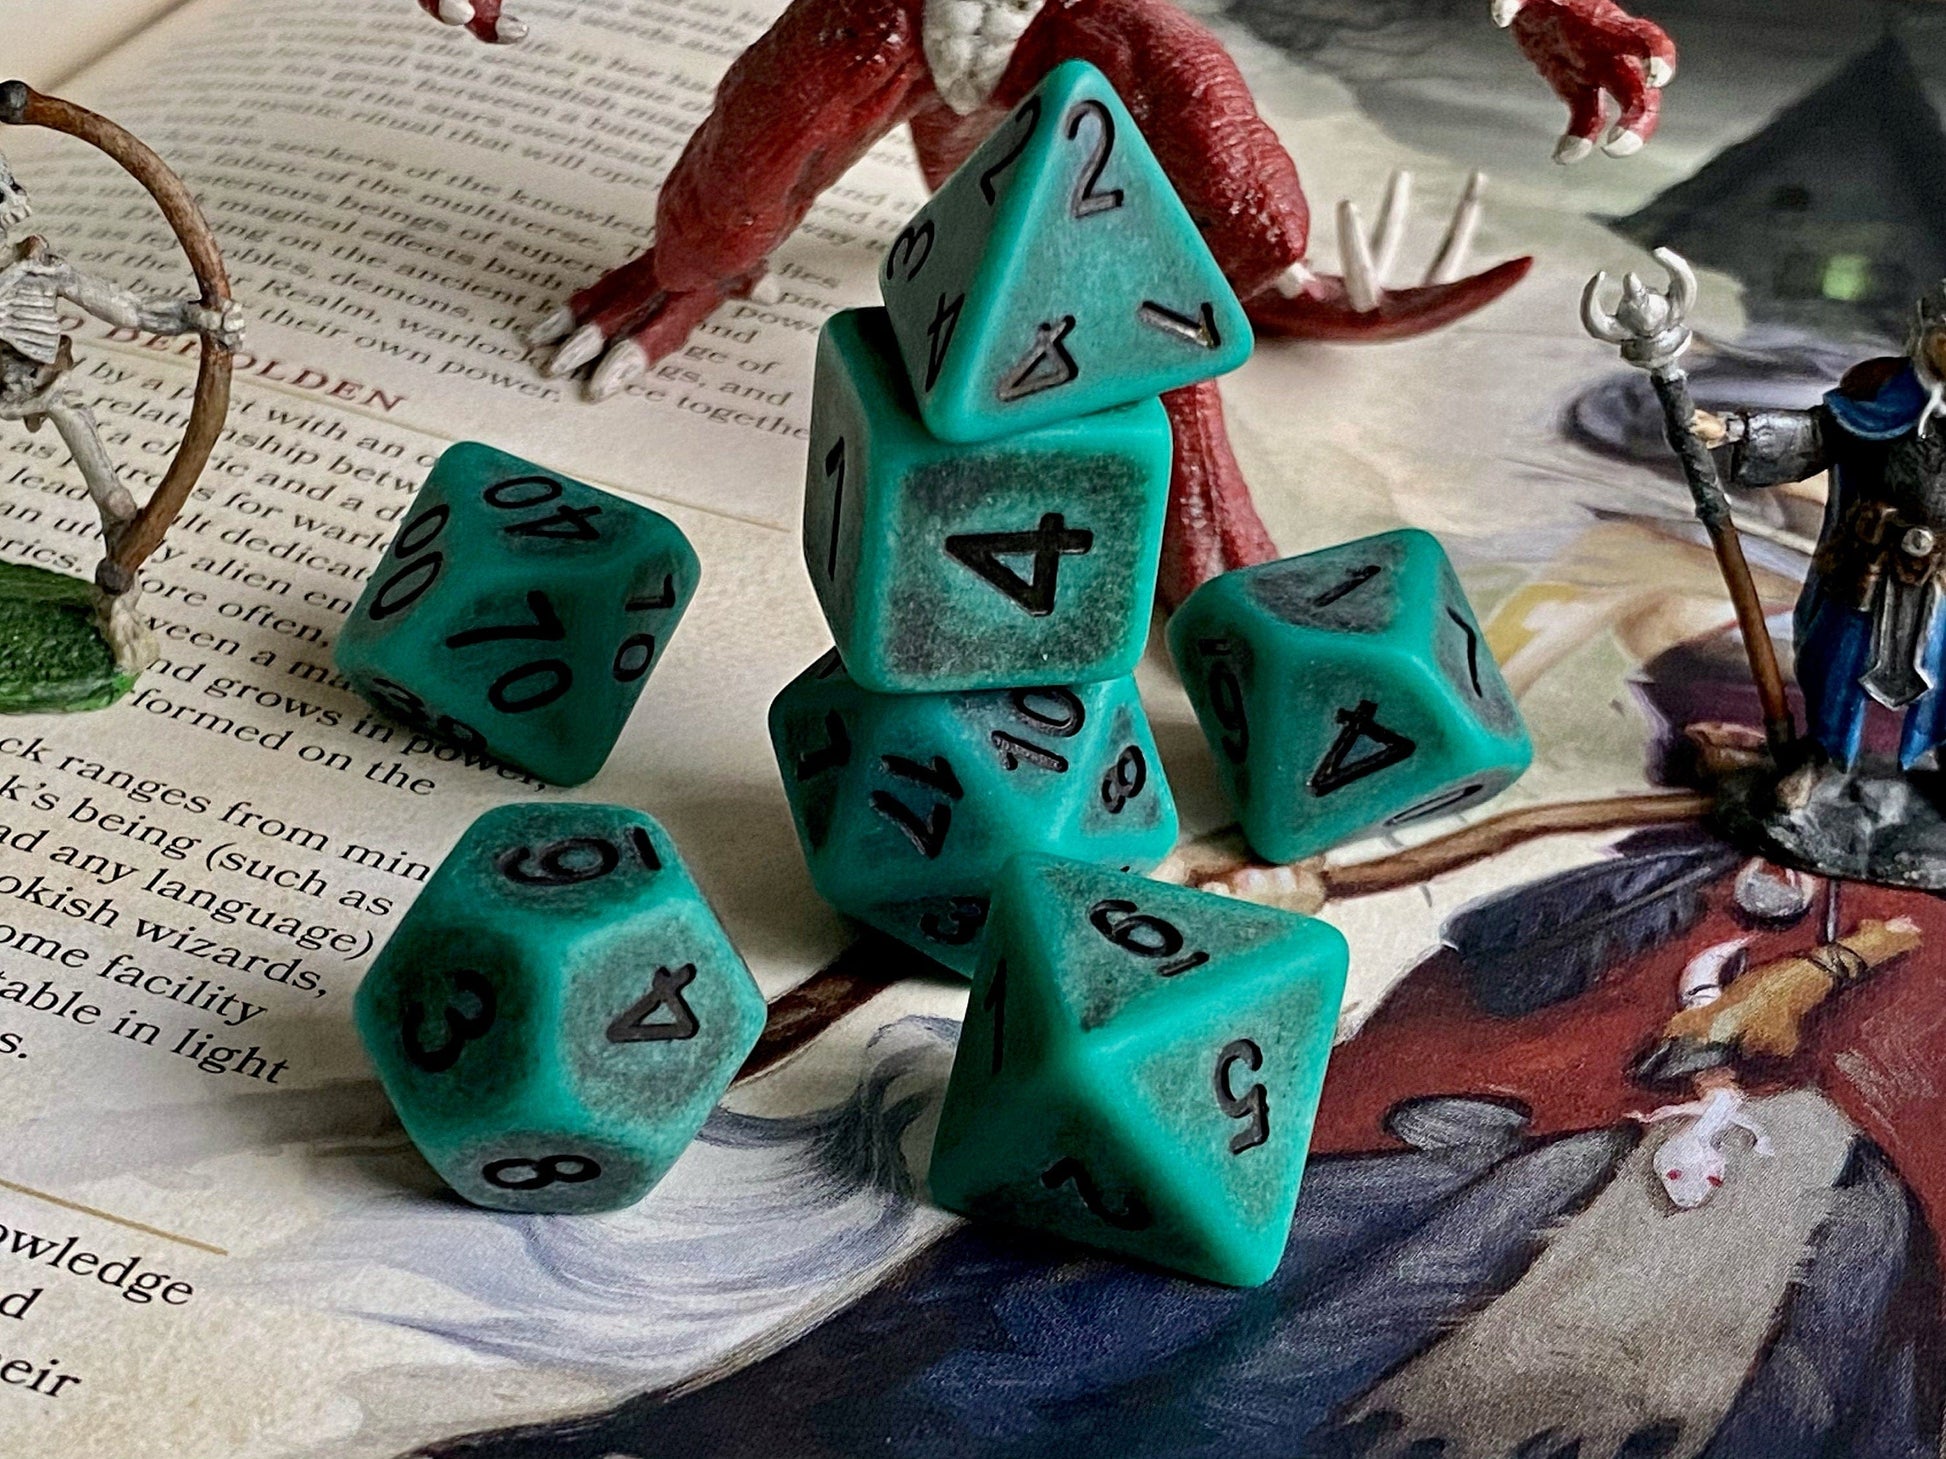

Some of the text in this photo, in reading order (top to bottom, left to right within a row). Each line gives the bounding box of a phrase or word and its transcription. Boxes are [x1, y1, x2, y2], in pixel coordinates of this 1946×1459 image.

[413, 78, 552, 118] between
[267, 142, 399, 172] seekers
[405, 167, 445, 182] of
[445, 175, 501, 194] the
[508, 189, 656, 236] knowled
[522, 147, 586, 170] will
[1064, 98, 1124, 219] 2
[212, 152, 308, 177] fabric
[313, 171, 357, 184] of
[356, 178, 409, 195] the
[772, 291, 833, 311] pac
[217, 200, 358, 234] magical
[362, 230, 476, 266] effects
[483, 257, 565, 291] both
[335, 195, 452, 234] beings
[459, 229, 500, 244] of
[886, 219, 935, 282] 3
[278, 236, 322, 252] on
[331, 246, 388, 265] the
[395, 264, 529, 308] ancient
[737, 359, 780, 374] of
[328, 272, 474, 323] demons,
[719, 382, 793, 406] and
[925, 292, 965, 393] 4
[258, 278, 381, 324] Realm,
[677, 397, 809, 438] togethe
[259, 308, 348, 338] their
[354, 336, 432, 364] own
[437, 360, 560, 402] power.
[999, 314, 1079, 401] 4
[88, 361, 134, 385] by
[141, 379, 164, 391] a
[268, 409, 348, 441] with
[356, 437, 405, 458] an
[9, 441, 57, 459] as
[223, 492, 284, 518] for
[106, 432, 132, 446] a
[255, 473, 338, 502] and
[339, 497, 364, 512] a
[327, 455, 415, 494] betw
[483, 476, 602, 541] 40
[824, 435, 846, 582] 1
[7, 467, 95, 501] lead
[220, 528, 370, 582] dedicat
[944, 511, 1094, 617] 4
[141, 579, 208, 606] ore
[218, 603, 338, 651] often,
[190, 558, 292, 596] alien
[146, 658, 207, 683] nd
[204, 678, 342, 726] grows
[352, 709, 404, 744] in
[250, 651, 277, 668] a
[129, 687, 436, 796] formed on the
[990, 687, 1085, 773] 10
[1305, 699, 1416, 798] 4
[57, 756, 212, 814] ranges
[218, 801, 329, 852] from
[67, 797, 202, 860] being
[206, 842, 328, 898] (such
[338, 890, 394, 916] as
[49, 846, 139, 885] any
[141, 868, 374, 962] language)
[97, 954, 266, 1027] facility
[136, 918, 328, 1001] wizards,
[606, 962, 700, 1044] 4
[109, 1009, 162, 1046] in
[171, 1032, 290, 1085] light
[402, 969, 497, 1073] 3
[1214, 1039, 1270, 1154] 5
[482, 1154, 602, 1191] 8
